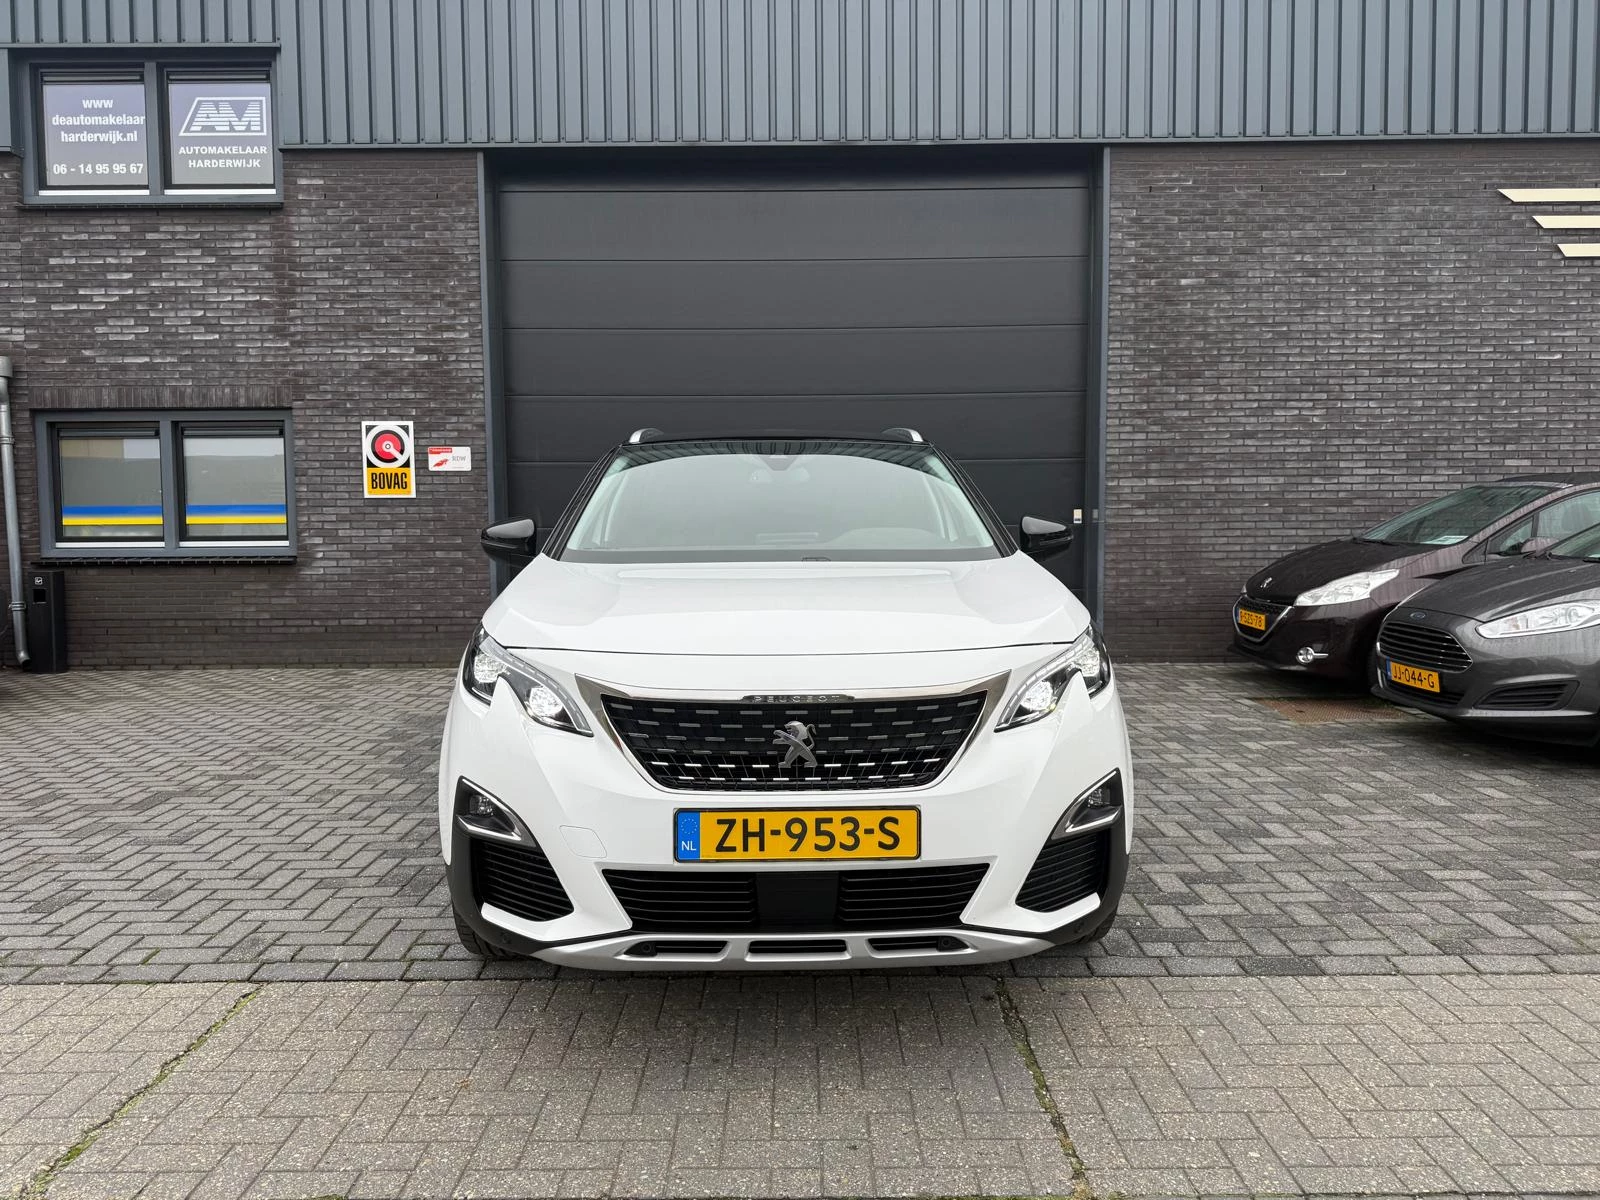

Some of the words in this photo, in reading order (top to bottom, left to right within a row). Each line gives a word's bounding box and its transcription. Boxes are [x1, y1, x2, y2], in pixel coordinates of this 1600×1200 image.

[82, 99, 114, 109] www
[52, 113, 146, 126] deautomakelaar
[189, 101, 261, 132] AM
[60, 130, 138, 144] harderwijk.nl
[178, 145, 268, 155] AUTOMAKELAAR
[53, 163, 67, 175] 06
[79, 163, 93, 175] 14
[96, 163, 110, 174] 95
[113, 163, 127, 174] 95
[130, 163, 144, 174] 67
[188, 158, 261, 168] HARDERWIJK
[370, 472, 408, 490] BOVAG
[1393, 665, 1435, 688] JJ-044-G
[715, 816, 901, 853] ZH-953-S
[681, 840, 697, 851] NL
